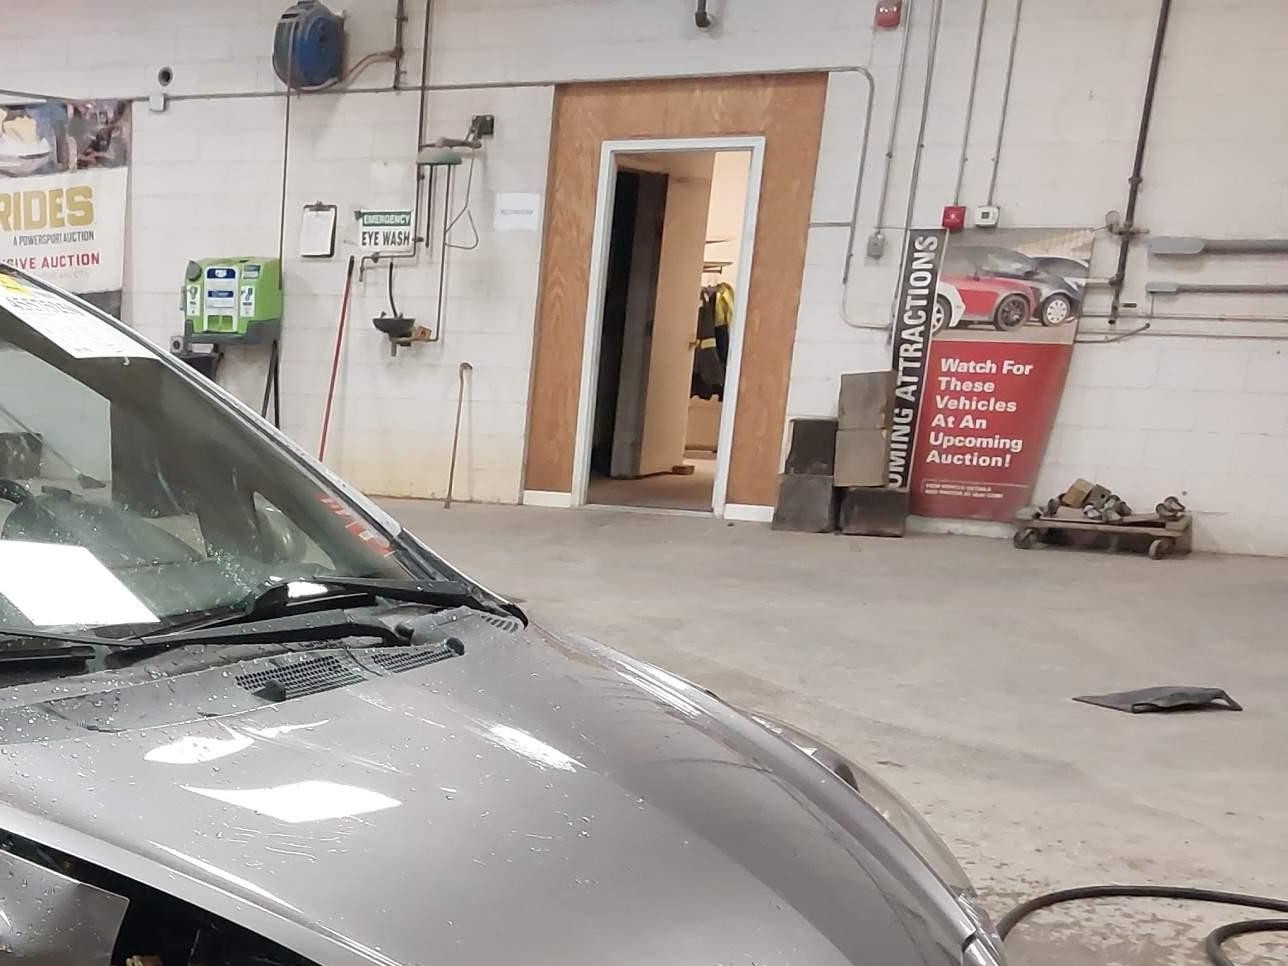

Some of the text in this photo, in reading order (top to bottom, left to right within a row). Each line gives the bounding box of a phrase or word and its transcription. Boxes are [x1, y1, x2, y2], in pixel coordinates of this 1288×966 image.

[364, 213, 410, 225] EMERGENCY
[13, 231, 95, 246] A POWERSPORT AUCTION
[362, 231, 410, 246] EYE WASH
[41, 252, 100, 269] AUCTION
[889, 235, 939, 489] OMING ATTRACTIONS
[940, 358, 1033, 375] Watch For
[938, 376, 995, 393] These
[935, 395, 1017, 412] Vehicles
[931, 414, 987, 430] At An
[929, 432, 1023, 452] Upcoming
[926, 450, 1011, 468] Auction!
